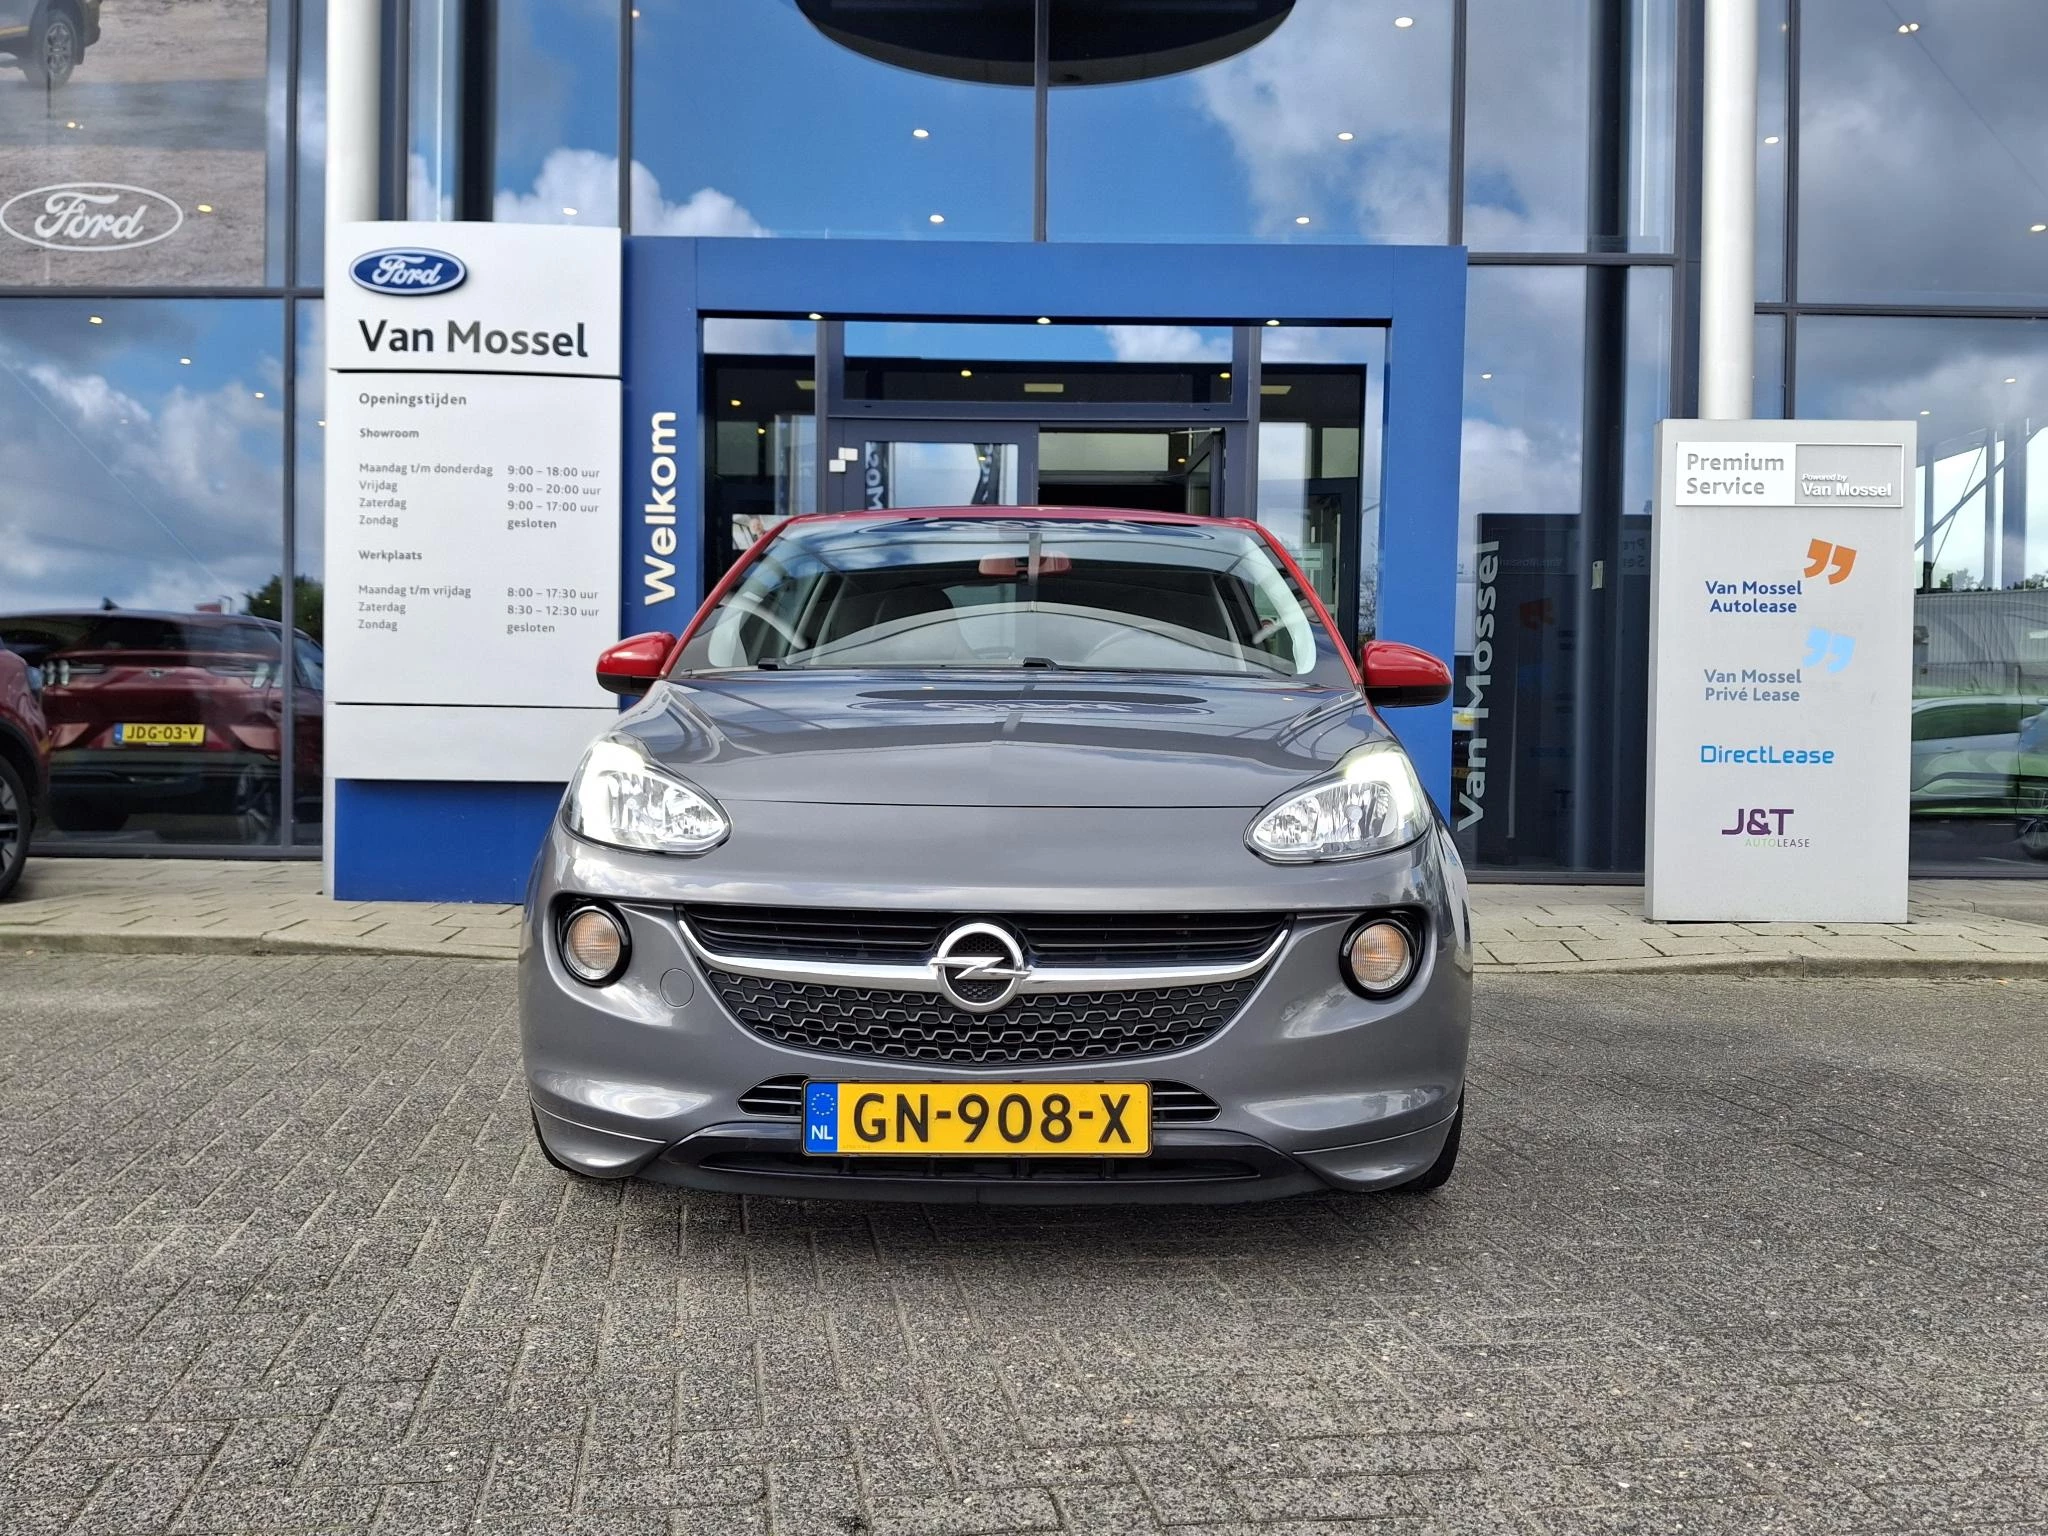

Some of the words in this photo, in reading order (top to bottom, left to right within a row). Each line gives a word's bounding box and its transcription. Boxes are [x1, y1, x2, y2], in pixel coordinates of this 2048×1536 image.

[34, 192, 148, 239] Ford
[371, 254, 443, 285] Ford
[358, 319, 434, 353] Van
[447, 320, 589, 358] Mossel
[358, 392, 467, 409] Openingstijden
[359, 427, 420, 439] Showroom
[1687, 452, 1785, 471] Premium
[359, 462, 408, 476] Maandag
[410, 463, 432, 474] t/m
[433, 463, 494, 478] donderdag
[507, 464, 534, 476] 9:00
[546, 466, 578, 478] 18:00
[581, 470, 600, 479] uur
[359, 479, 398, 494] Vrijdag
[507, 482, 534, 494] 9:00
[546, 483, 580, 495] 20:00
[582, 487, 602, 496] uur
[1686, 477, 1765, 495] Service
[1802, 483, 1831, 497] Van
[1836, 482, 1892, 498] Mossel
[359, 497, 408, 511] Zaterdag
[507, 499, 534, 511] 9:00
[546, 501, 577, 512] 17:00
[580, 504, 599, 513] uur
[644, 412, 677, 606] Welkom
[359, 514, 399, 529] Zondag
[507, 518, 557, 531] gesloten
[358, 550, 423, 563] Werkplaats
[358, 584, 407, 598] Maandag
[409, 584, 431, 596] t/m
[432, 585, 472, 599] vrijdag
[507, 586, 534, 598] 8:00
[545, 588, 577, 599] 17:30
[579, 591, 598, 600] uur
[1704, 580, 1737, 595] Van
[1742, 579, 1803, 596] Mossel
[358, 601, 407, 616] Zaterdag
[507, 604, 533, 615] 8:30
[545, 605, 578, 616] 12:30
[580, 609, 600, 617] uur
[1709, 598, 1798, 614] Autolease
[357, 618, 398, 633] Zondag
[506, 622, 556, 635] gesloten
[1463, 540, 1500, 719] Mossel
[1703, 668, 1737, 684] Van
[1741, 668, 1802, 684] Mossel
[1705, 686, 1749, 702] Privé
[1752, 687, 1801, 702] Lease
[127, 726, 198, 740] JDG-03-V
[1700, 745, 1835, 764] DirectLease
[1457, 738, 1488, 832] Van
[1721, 808, 1795, 836] J&T
[1744, 838, 1811, 849] AUTOLEASE
[853, 1092, 1132, 1144] GN-908-X
[811, 1124, 834, 1141] NL
